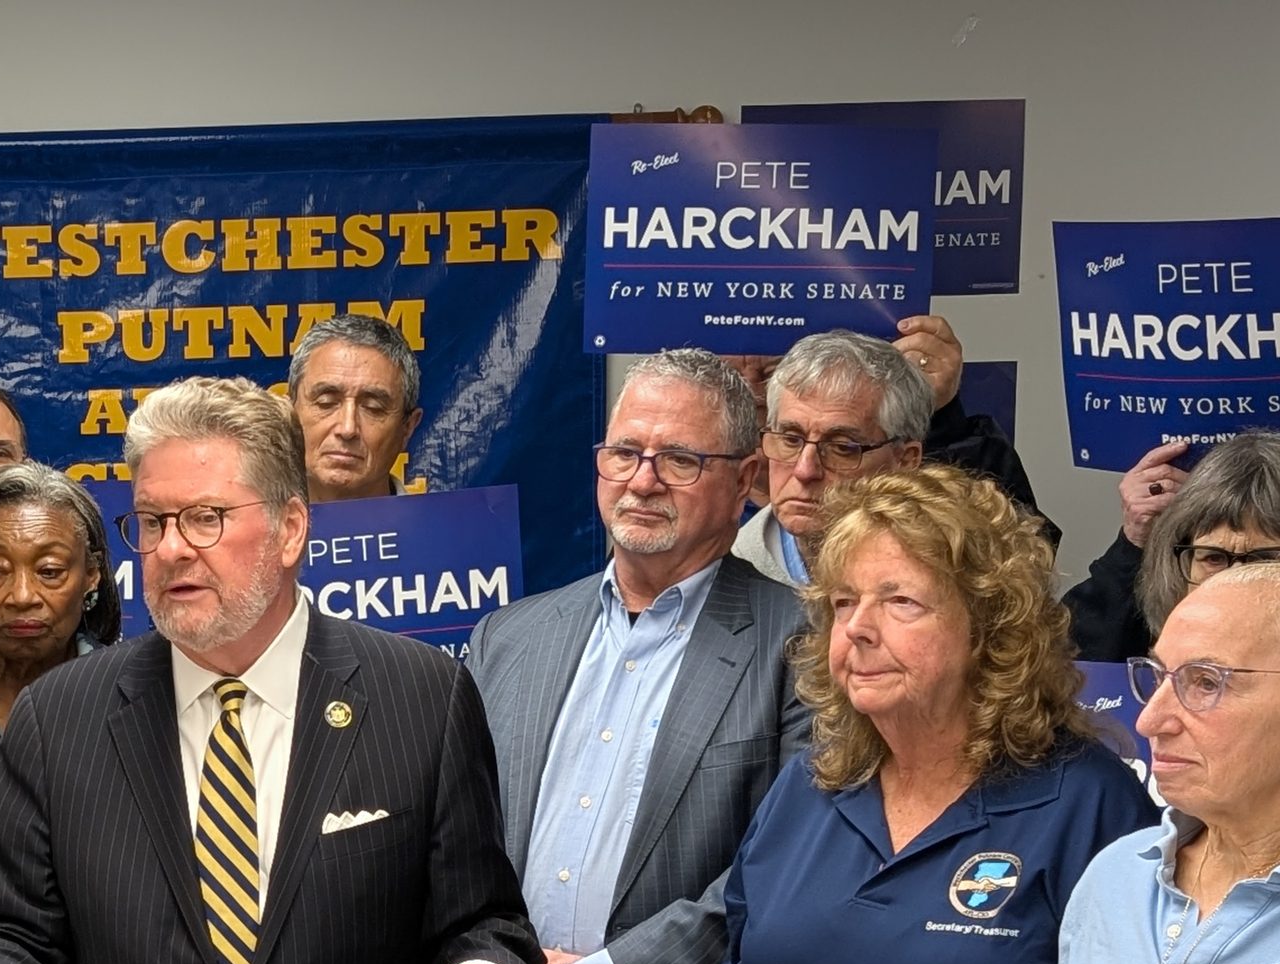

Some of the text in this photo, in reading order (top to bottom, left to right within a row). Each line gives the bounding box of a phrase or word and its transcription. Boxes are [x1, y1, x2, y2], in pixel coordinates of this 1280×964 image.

[632, 153, 679, 174] Re-Elect
[716, 162, 810, 188] PETE
[604, 207, 918, 251] HARCKHAM
[934, 232, 1001, 248] ENATE
[1086, 254, 1124, 277] Re-Elect
[1158, 262, 1253, 293] PETE
[610, 281, 904, 299] for NEW YORK SENATE
[705, 315, 804, 325] PeteForNY.com
[1071, 311, 1280, 361] HARCKH
[1085, 392, 1110, 411] for
[1120, 395, 1167, 414] NEW
[1179, 397, 1254, 414] YORK
[1161, 433, 1237, 445] PeteForNY
[309, 533, 398, 566] PETE
[300, 566, 510, 620] CKHAM
[1076, 695, 1122, 712] -Elect
